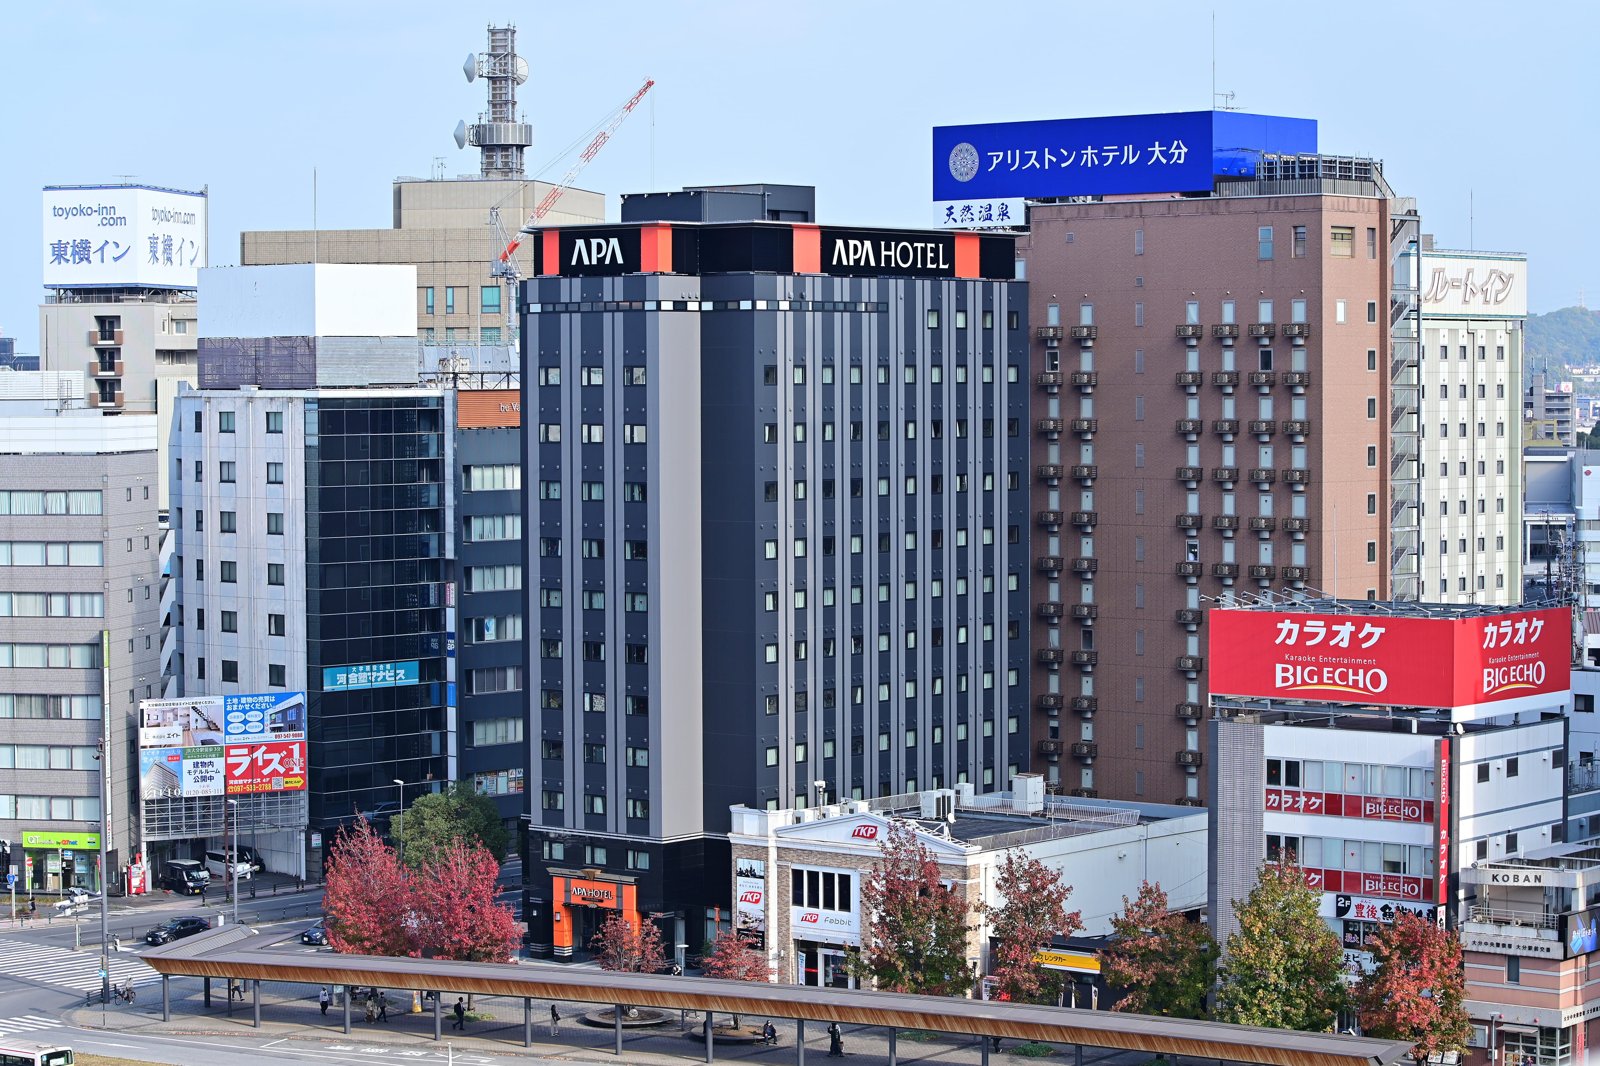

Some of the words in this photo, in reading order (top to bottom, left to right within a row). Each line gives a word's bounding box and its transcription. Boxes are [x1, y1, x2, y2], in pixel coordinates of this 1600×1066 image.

[986, 143, 1141, 172] アリストンホテル
[1147, 139, 1189, 165] 大分
[52, 203, 117, 220] toyoko-inn
[151, 206, 196, 225] toyoko-inn.com
[944, 201, 1012, 224] 天然温泉
[97, 214, 127, 227] .com
[49, 239, 131, 265] 東横イン
[147, 233, 200, 267] 東横イン
[570, 238, 625, 266] APA
[832, 238, 876, 267] APA
[880, 241, 950, 270] HOTEL
[1423, 267, 1515, 305] ルートイン
[1274, 619, 1386, 649] カラオケ
[1483, 616, 1544, 650] カラオケ
[1284, 653, 1316, 663] Karaoke
[1319, 655, 1376, 665] Entertainment
[1488, 655, 1507, 664] Karaoke
[1507, 651, 1540, 662] Entertainment
[336, 669, 406, 685] 河合塾マナビス
[1275, 663, 1318, 688] BIG
[1323, 667, 1387, 693] ECHO
[1483, 664, 1508, 694] BIG
[1510, 660, 1546, 688] ECHO
[193, 760, 214, 768] 建物内
[227, 745, 288, 777] ライズ
[288, 743, 305, 774] 1
[187, 768, 220, 776] モデルルーム
[193, 775, 214, 783] 公開中
[1267, 793, 1322, 811] カラオケ
[1366, 802, 1387, 815] BIG
[1389, 804, 1420, 819] ECHO
[853, 826, 876, 839] TKP
[1439, 830, 1447, 885] カラオケ
[1491, 873, 1542, 883] KOBAN
[571, 887, 587, 897] APA
[587, 889, 613, 900] HOTEL
[1365, 880, 1386, 893] BIG
[1388, 882, 1420, 896] ECHO
[741, 892, 761, 905] TKP
[1337, 897, 1351, 908] 2F
[801, 913, 819, 924] TKP
[1353, 903, 1378, 919] 豊後
[1044, 954, 1067, 963] レンタカー
